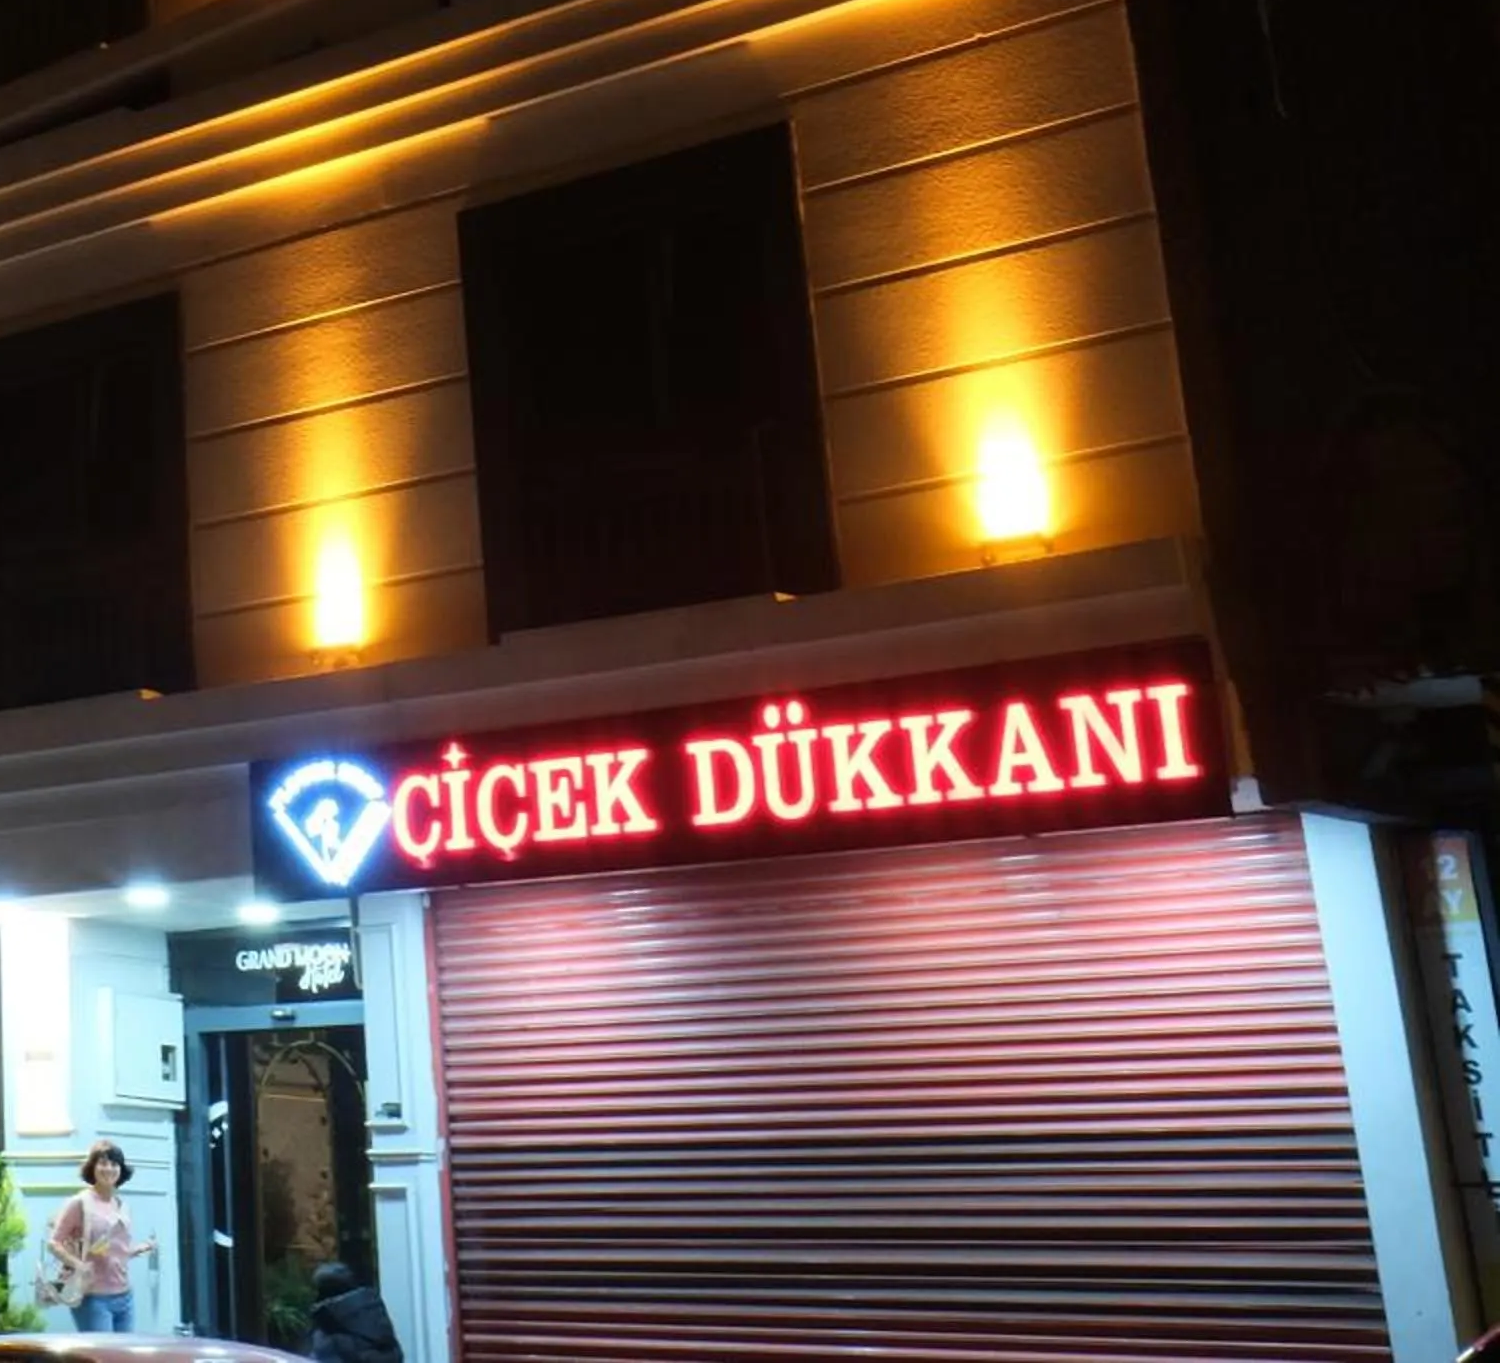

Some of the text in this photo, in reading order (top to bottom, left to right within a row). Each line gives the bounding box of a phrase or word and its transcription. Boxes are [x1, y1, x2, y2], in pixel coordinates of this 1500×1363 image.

[393, 684, 1200, 869] ÇİÇEK DÜKKANI
[235, 943, 293, 971] GRAND
